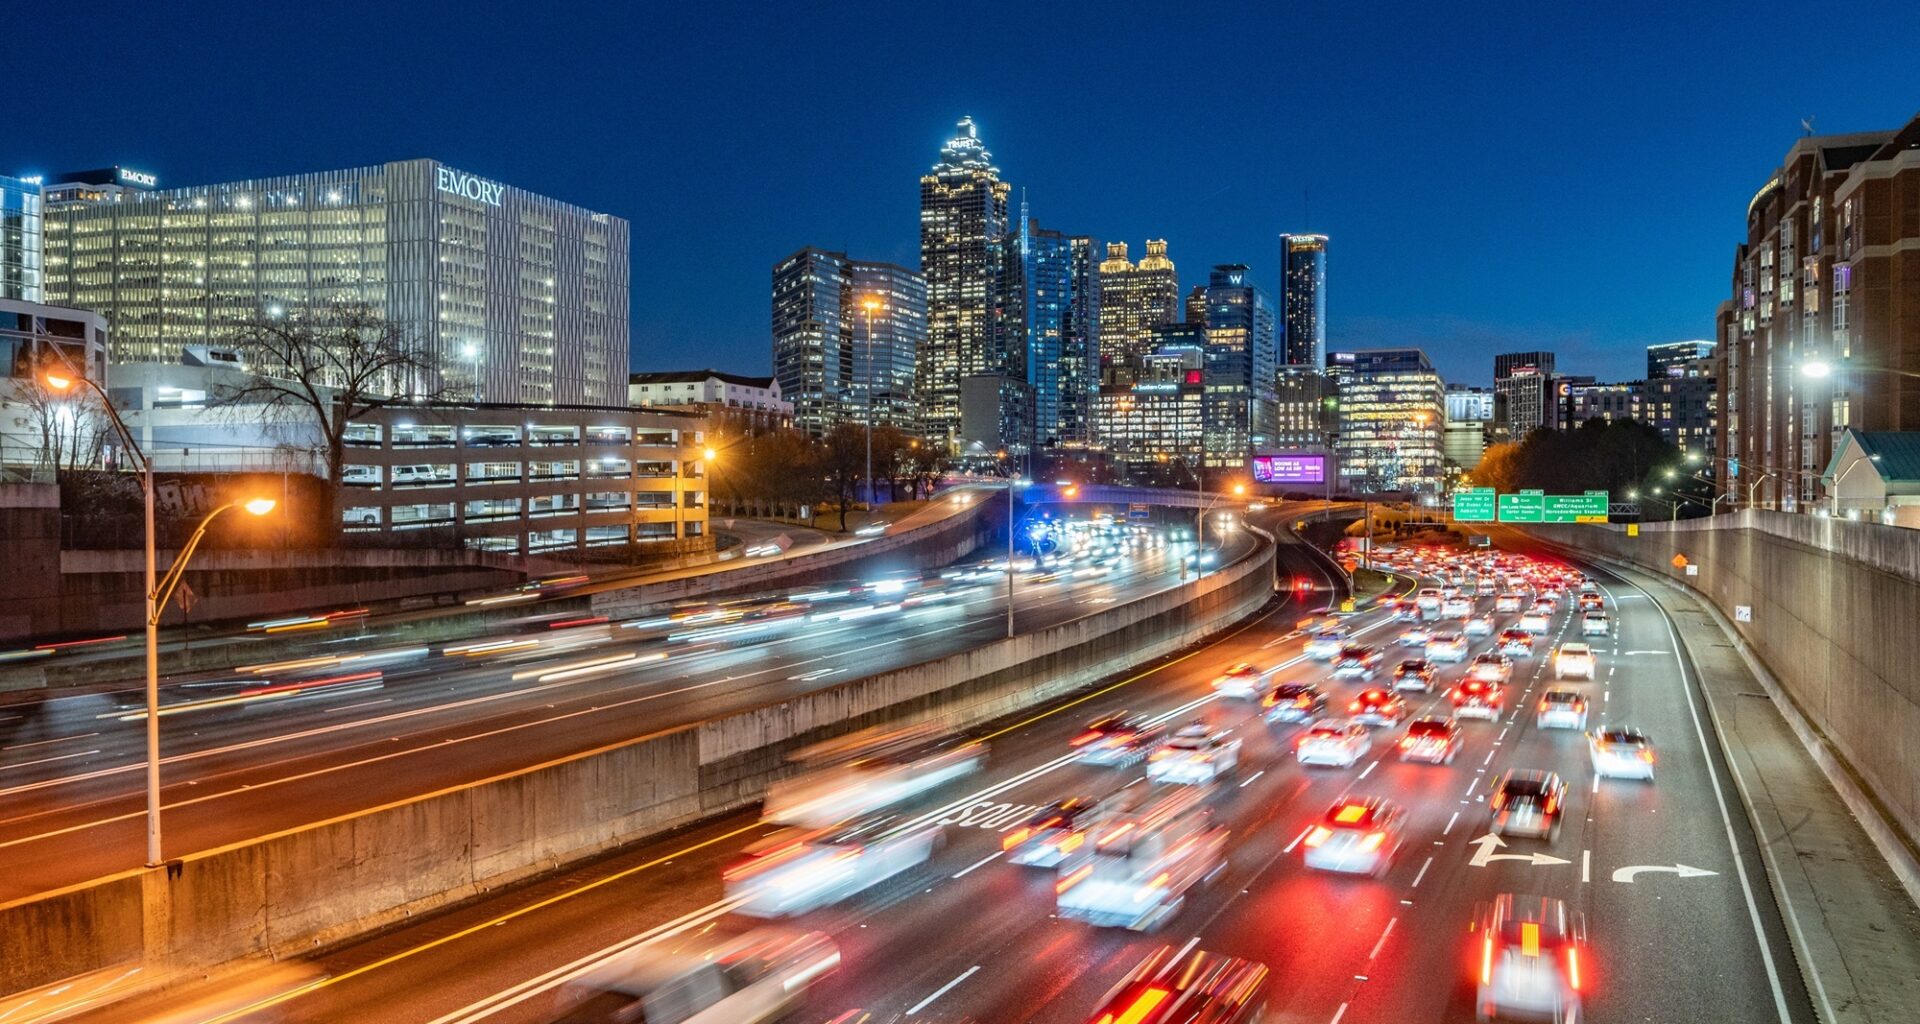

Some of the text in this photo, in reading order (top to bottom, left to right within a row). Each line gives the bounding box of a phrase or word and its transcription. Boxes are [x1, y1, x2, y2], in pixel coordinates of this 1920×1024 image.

[947, 139, 975, 149] TRUIST
[121, 169, 156, 186] EMORY
[437, 167, 504, 207] EMORY
[1229, 275, 1242, 284] W
[1372, 356, 1383, 364] EY
[1559, 383, 1571, 396] G
